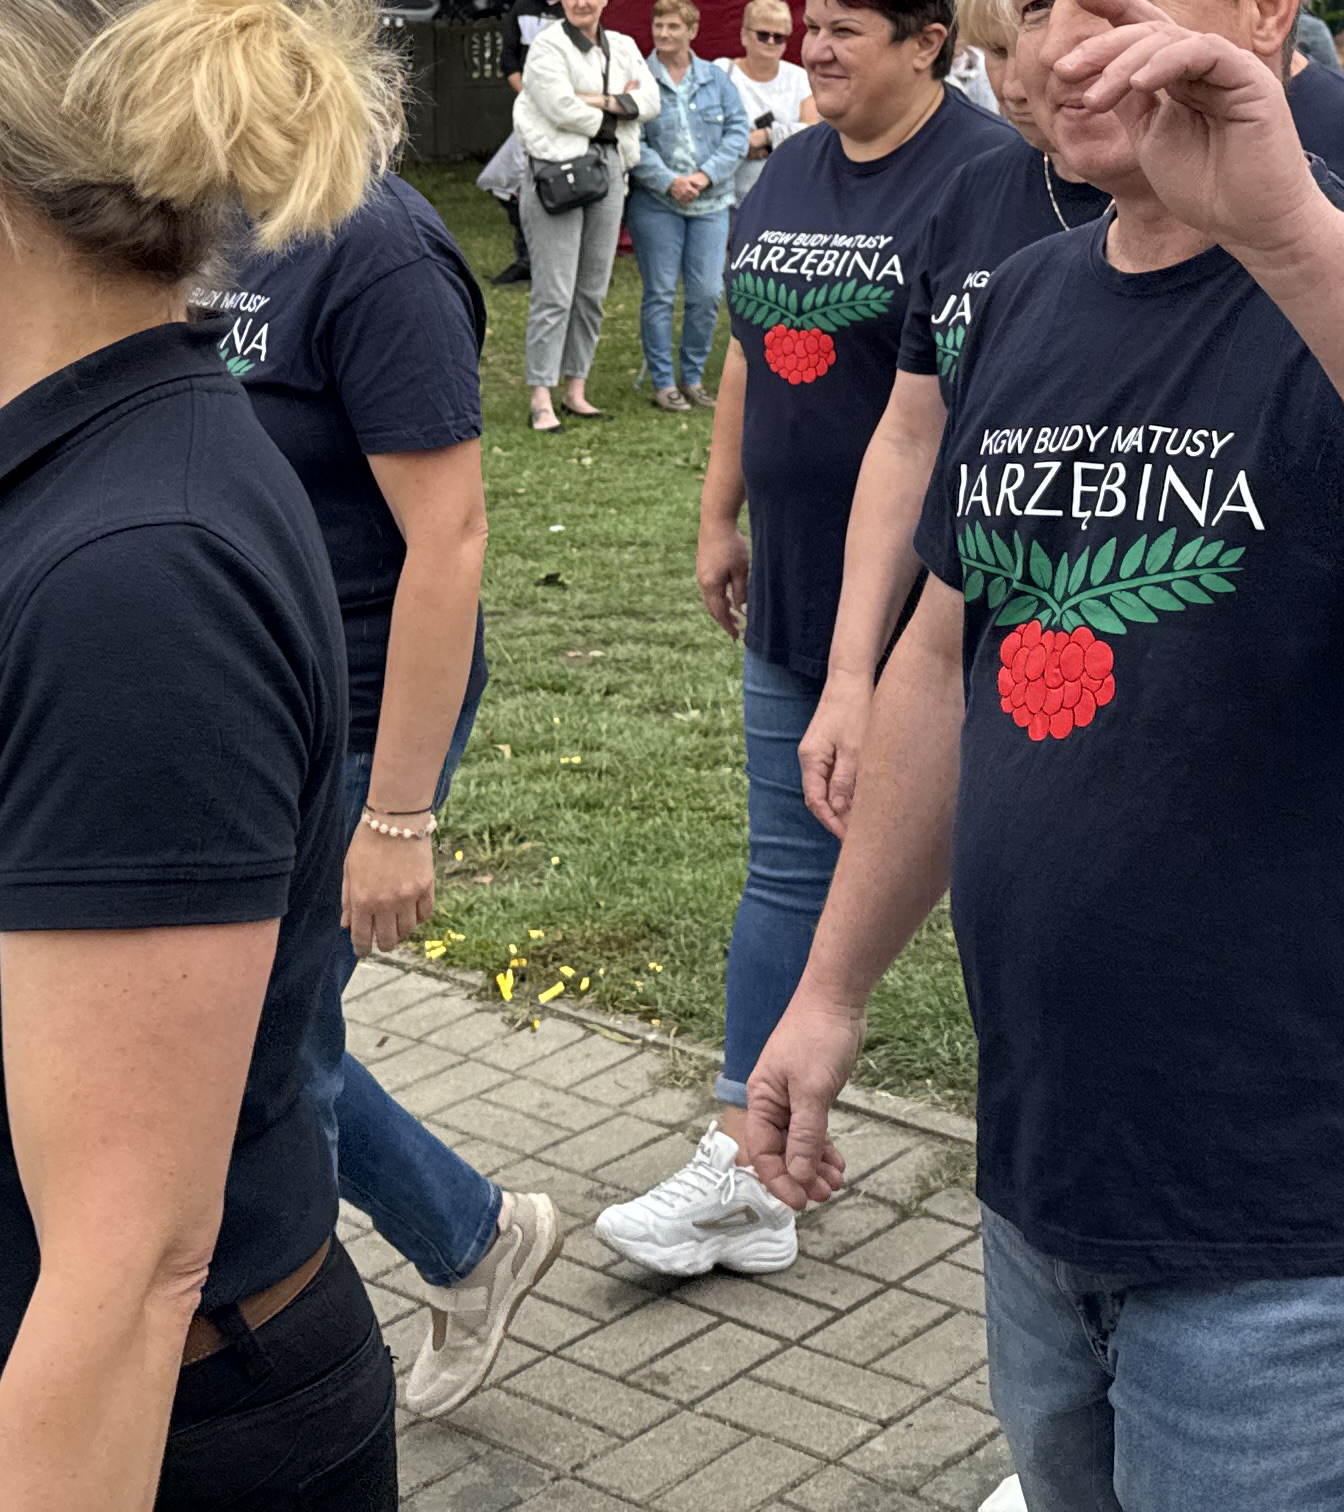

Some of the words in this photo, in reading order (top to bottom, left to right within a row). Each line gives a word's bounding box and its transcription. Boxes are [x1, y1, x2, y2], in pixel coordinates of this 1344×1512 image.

[758, 230, 797, 245] KGW
[794, 232, 833, 247] BUDY
[829, 233, 893, 250] MATUSY
[731, 243, 904, 285] JARZĘBINA
[962, 270, 991, 290] KG
[931, 292, 972, 326] JA
[980, 428, 1033, 456] KGW
[1033, 424, 1108, 454] BUDY
[1110, 424, 1235, 459] MATUSY
